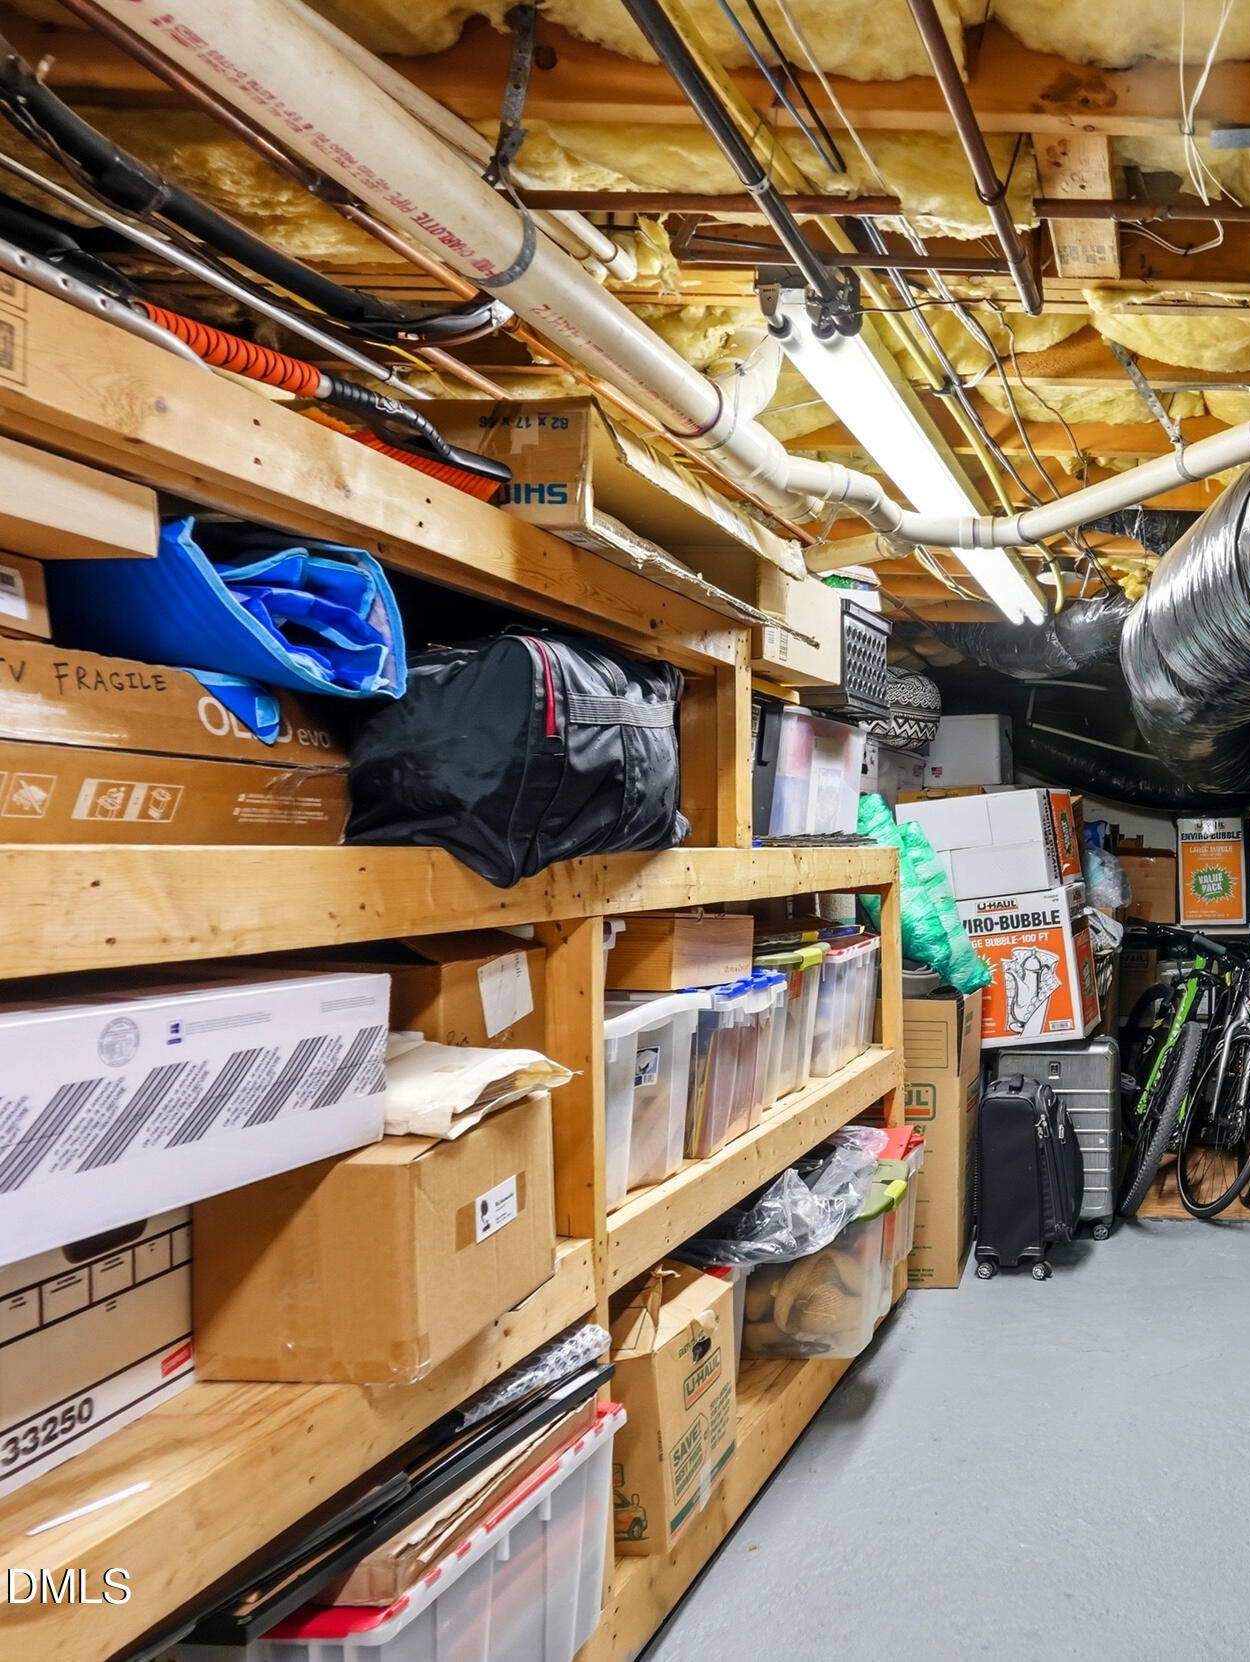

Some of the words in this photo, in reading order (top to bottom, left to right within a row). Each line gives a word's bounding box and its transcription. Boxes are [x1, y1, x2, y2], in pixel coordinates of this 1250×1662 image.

[384, 191, 419, 214] PIPE
[410, 211, 476, 258] CHARLOTTE
[52, 661, 168, 696] FRAGILE
[197, 697, 293, 744] OL
[297, 727, 332, 749] evo
[1198, 873, 1224, 884] VALUE
[1201, 883, 1223, 893] PACK
[977, 900, 1016, 910] U-HAUL
[1038, 932, 1049, 941] FT
[685, 1357, 720, 1395] U-HAUL
[1, 1397, 94, 1467] 33250
[671, 1420, 702, 1468] SAVE!
